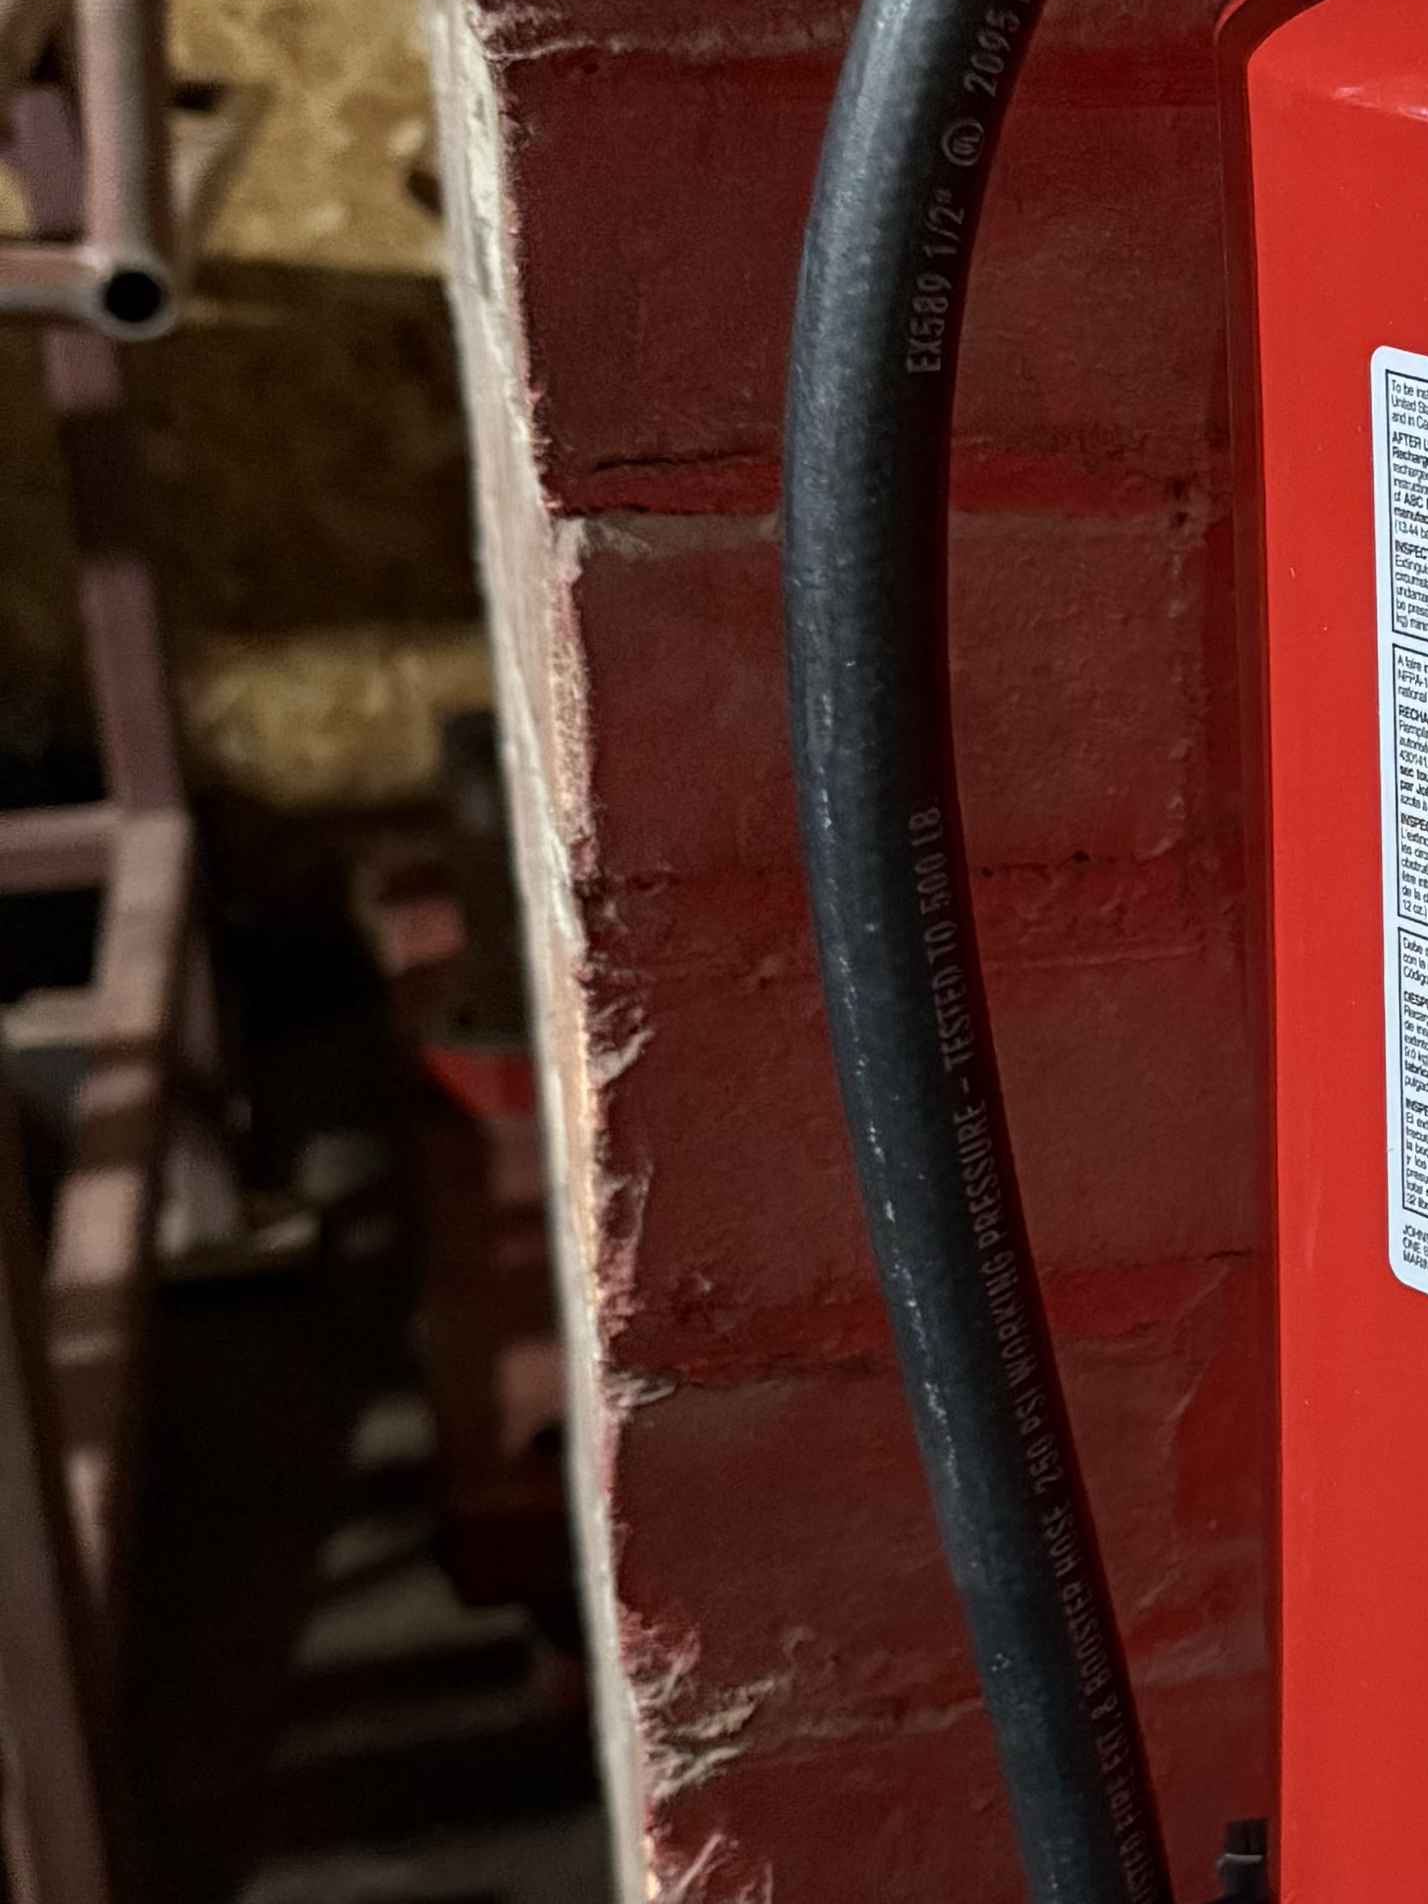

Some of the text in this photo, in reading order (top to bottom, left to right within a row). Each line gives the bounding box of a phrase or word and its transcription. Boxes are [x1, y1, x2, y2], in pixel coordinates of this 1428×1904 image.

[924, 920, 960, 958] TO
[929, 967, 976, 1070] TESTED
[953, 1100, 1009, 1245] PRESSURE
[1013, 1387, 1048, 1428] PSI
[1041, 1503, 1082, 1572] HOSE
